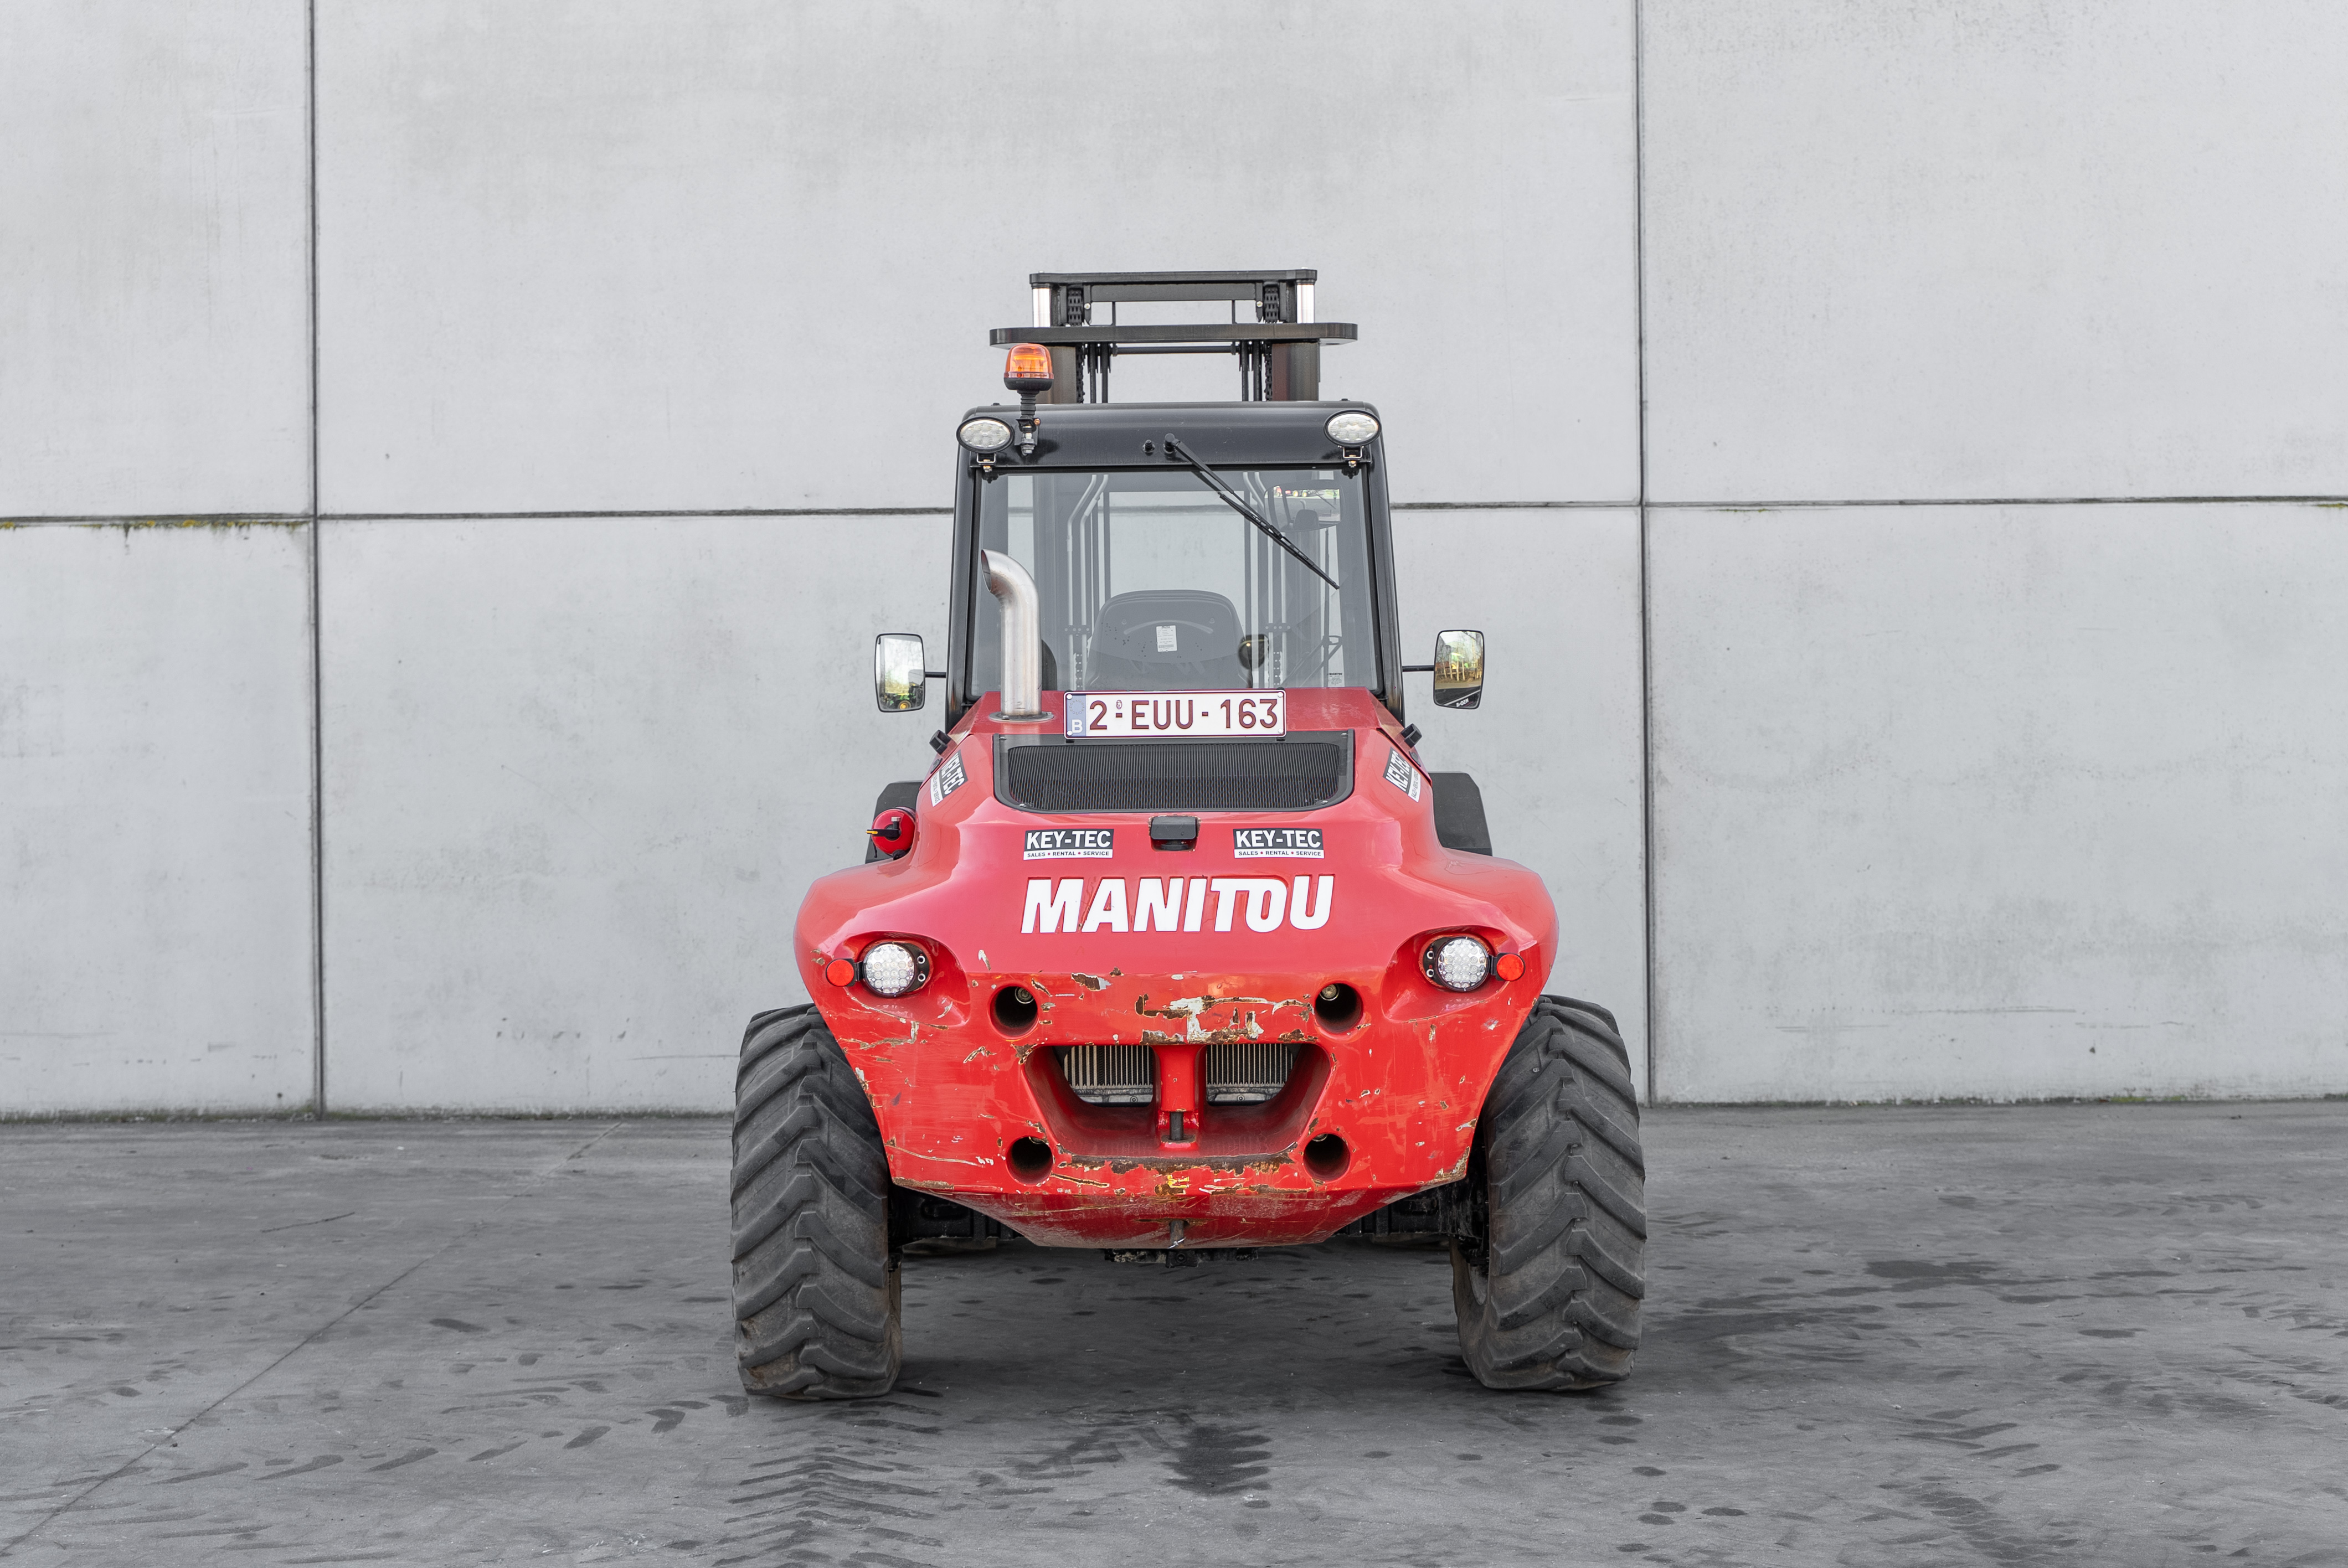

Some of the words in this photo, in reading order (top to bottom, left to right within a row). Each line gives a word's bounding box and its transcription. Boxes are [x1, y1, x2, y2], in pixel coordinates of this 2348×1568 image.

[1072, 719, 1083, 733] B
[941, 752, 965, 795] KEY-TEC
[1386, 750, 1410, 792] KEY-TEC
[1027, 831, 1111, 849] KEY-TEC
[1235, 830, 1321, 848] KEY-TEC
[1021, 875, 1335, 933] MANITOU
